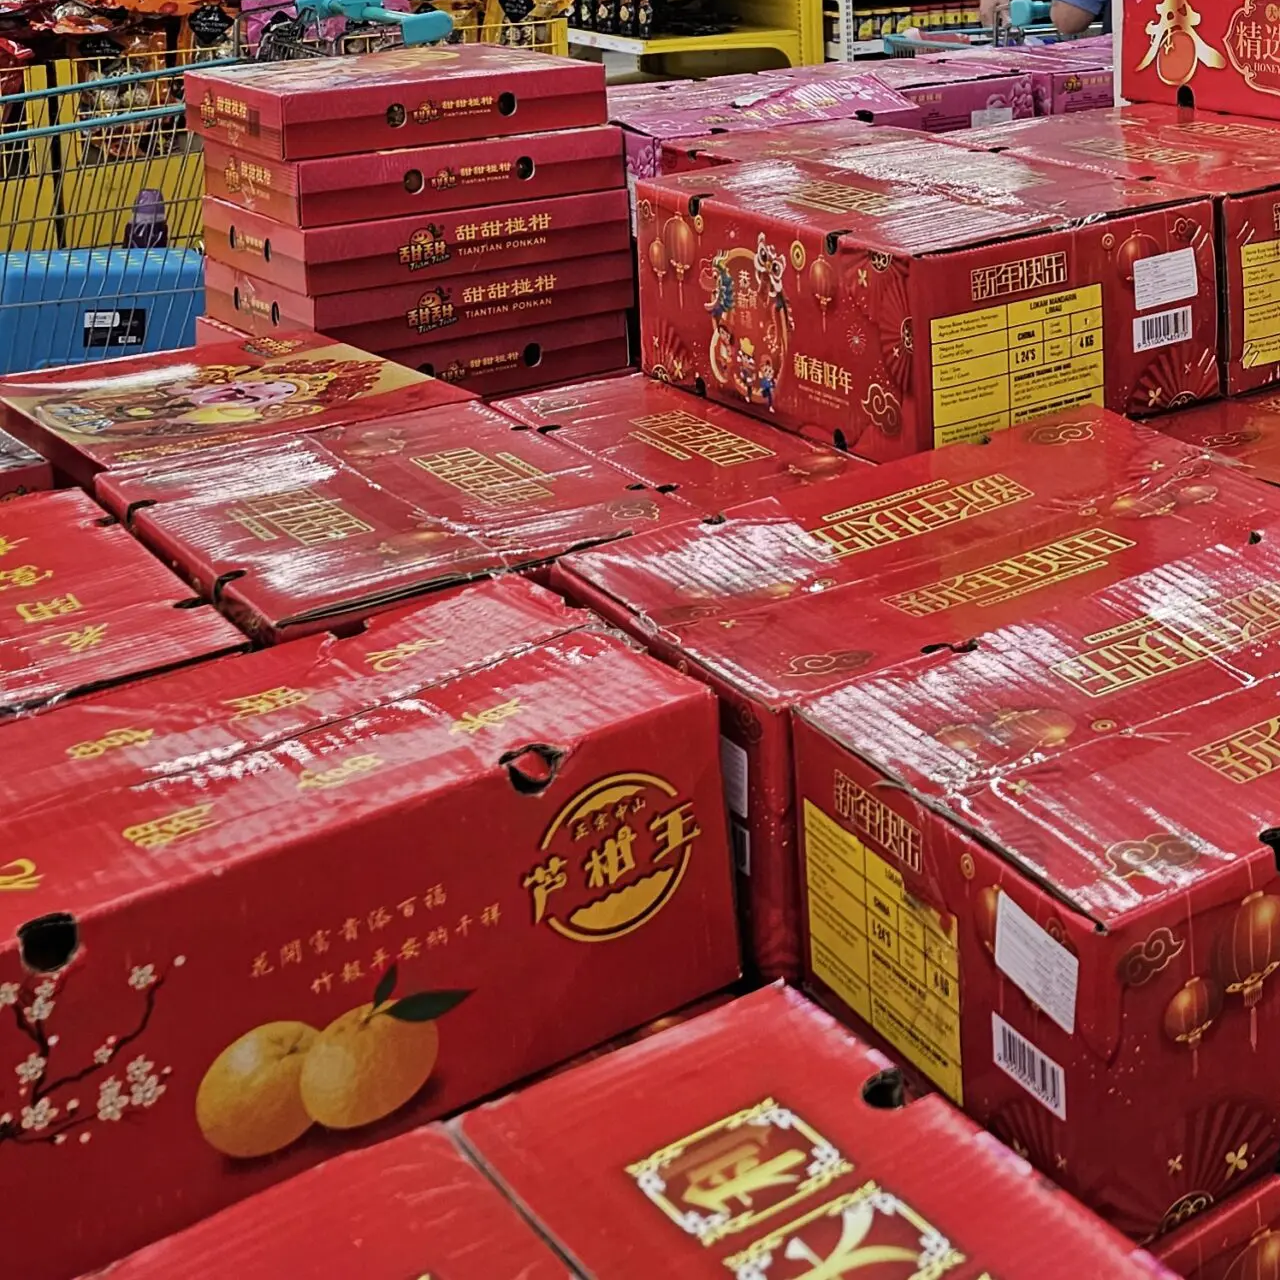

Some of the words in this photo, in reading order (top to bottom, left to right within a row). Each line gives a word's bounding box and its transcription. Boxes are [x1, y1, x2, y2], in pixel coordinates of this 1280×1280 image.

[455, 213, 552, 241] 甜甜椪柑
[458, 242, 503, 256] TIANTIAN
[506, 236, 547, 249] PONKAN
[462, 274, 557, 303] 甜甜椪柑
[971, 251, 1068, 301] 新年快乐
[465, 305, 509, 318] TIANTIAN
[512, 297, 552, 311] PONKAN
[1017, 330, 1035, 341] CHINA
[523, 802, 701, 924] 芦柑王
